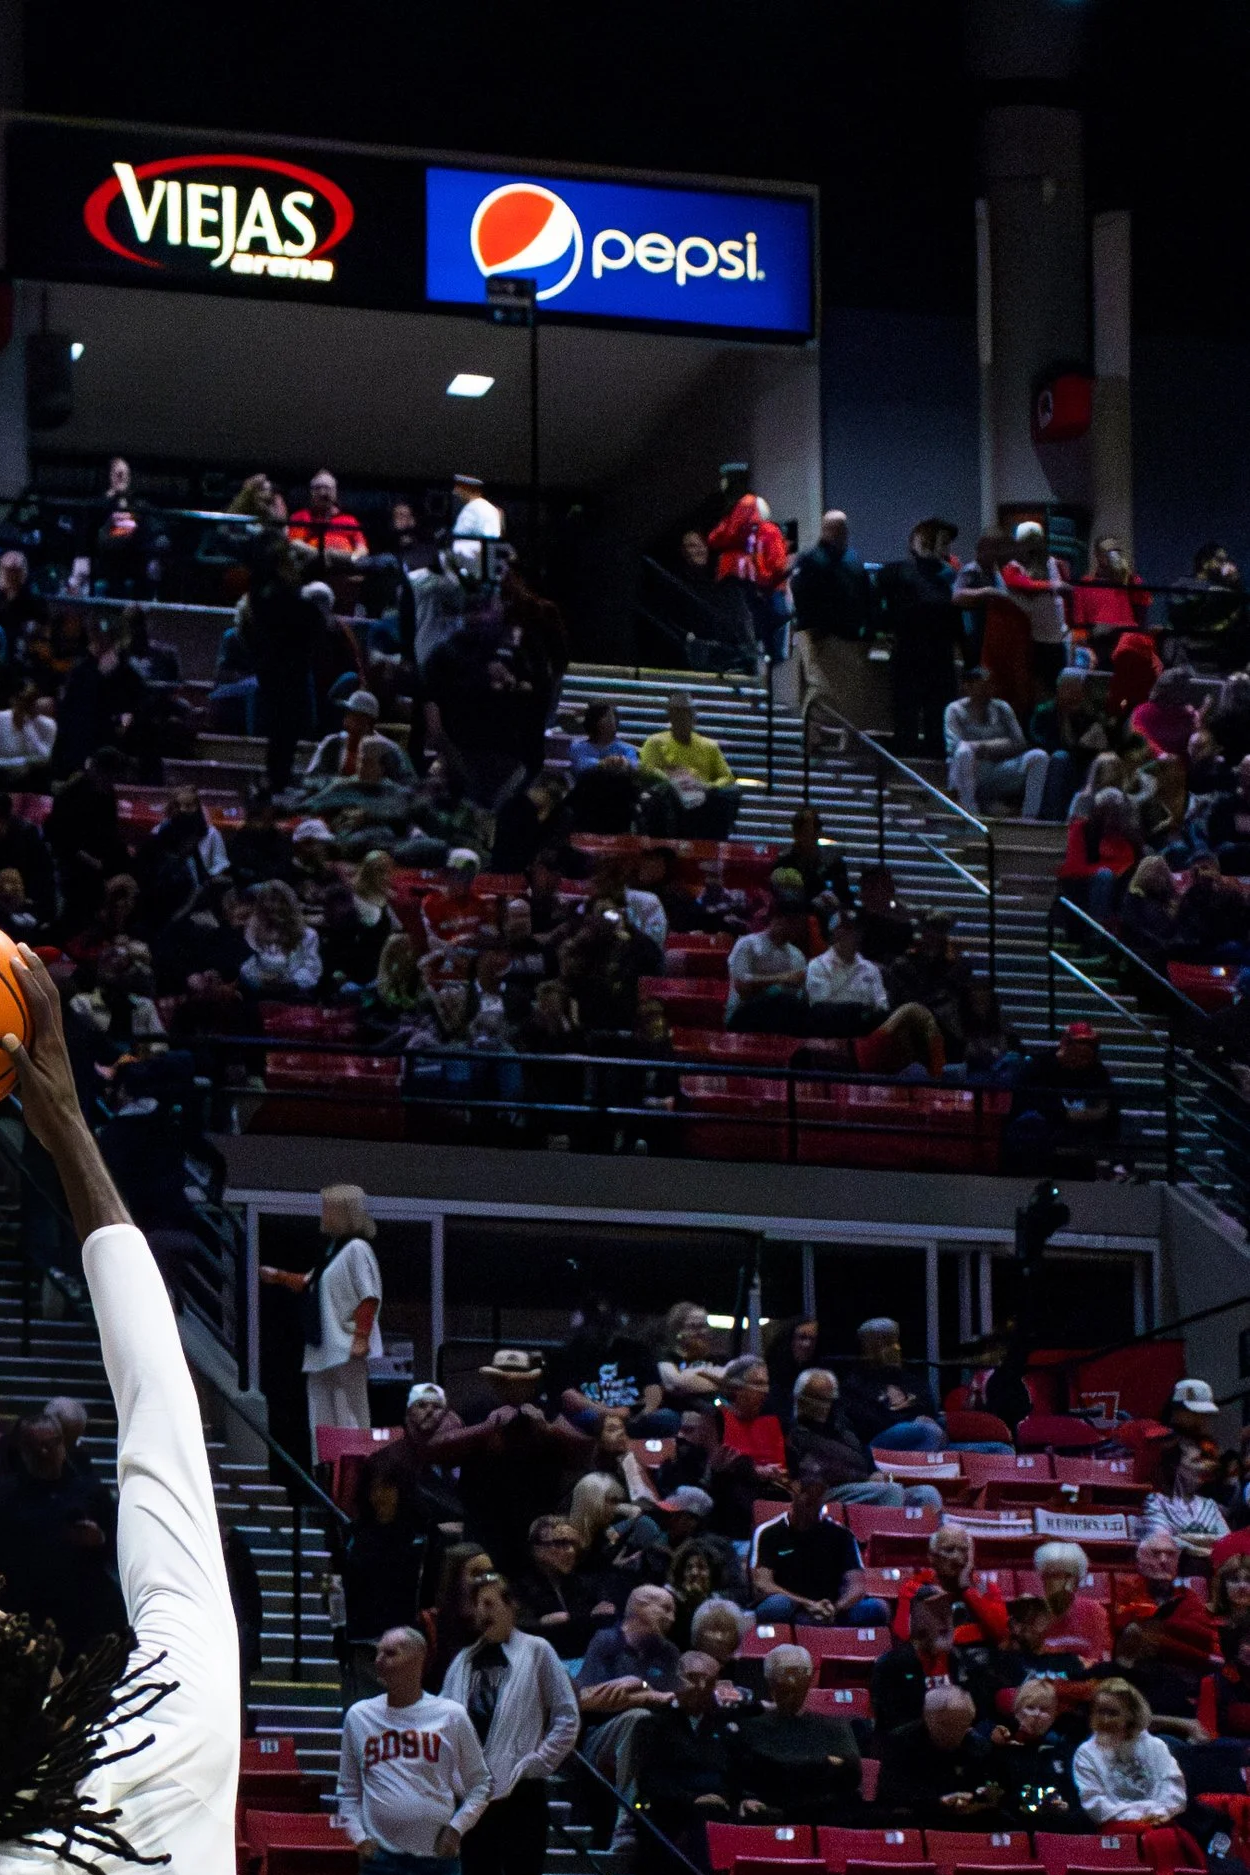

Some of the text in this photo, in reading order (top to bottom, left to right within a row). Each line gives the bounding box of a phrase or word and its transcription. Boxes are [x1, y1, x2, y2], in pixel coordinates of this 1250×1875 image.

[113, 161, 317, 269] VIEJAS
[592, 229, 758, 287] pepsi
[363, 1728, 442, 1770] SDSU
